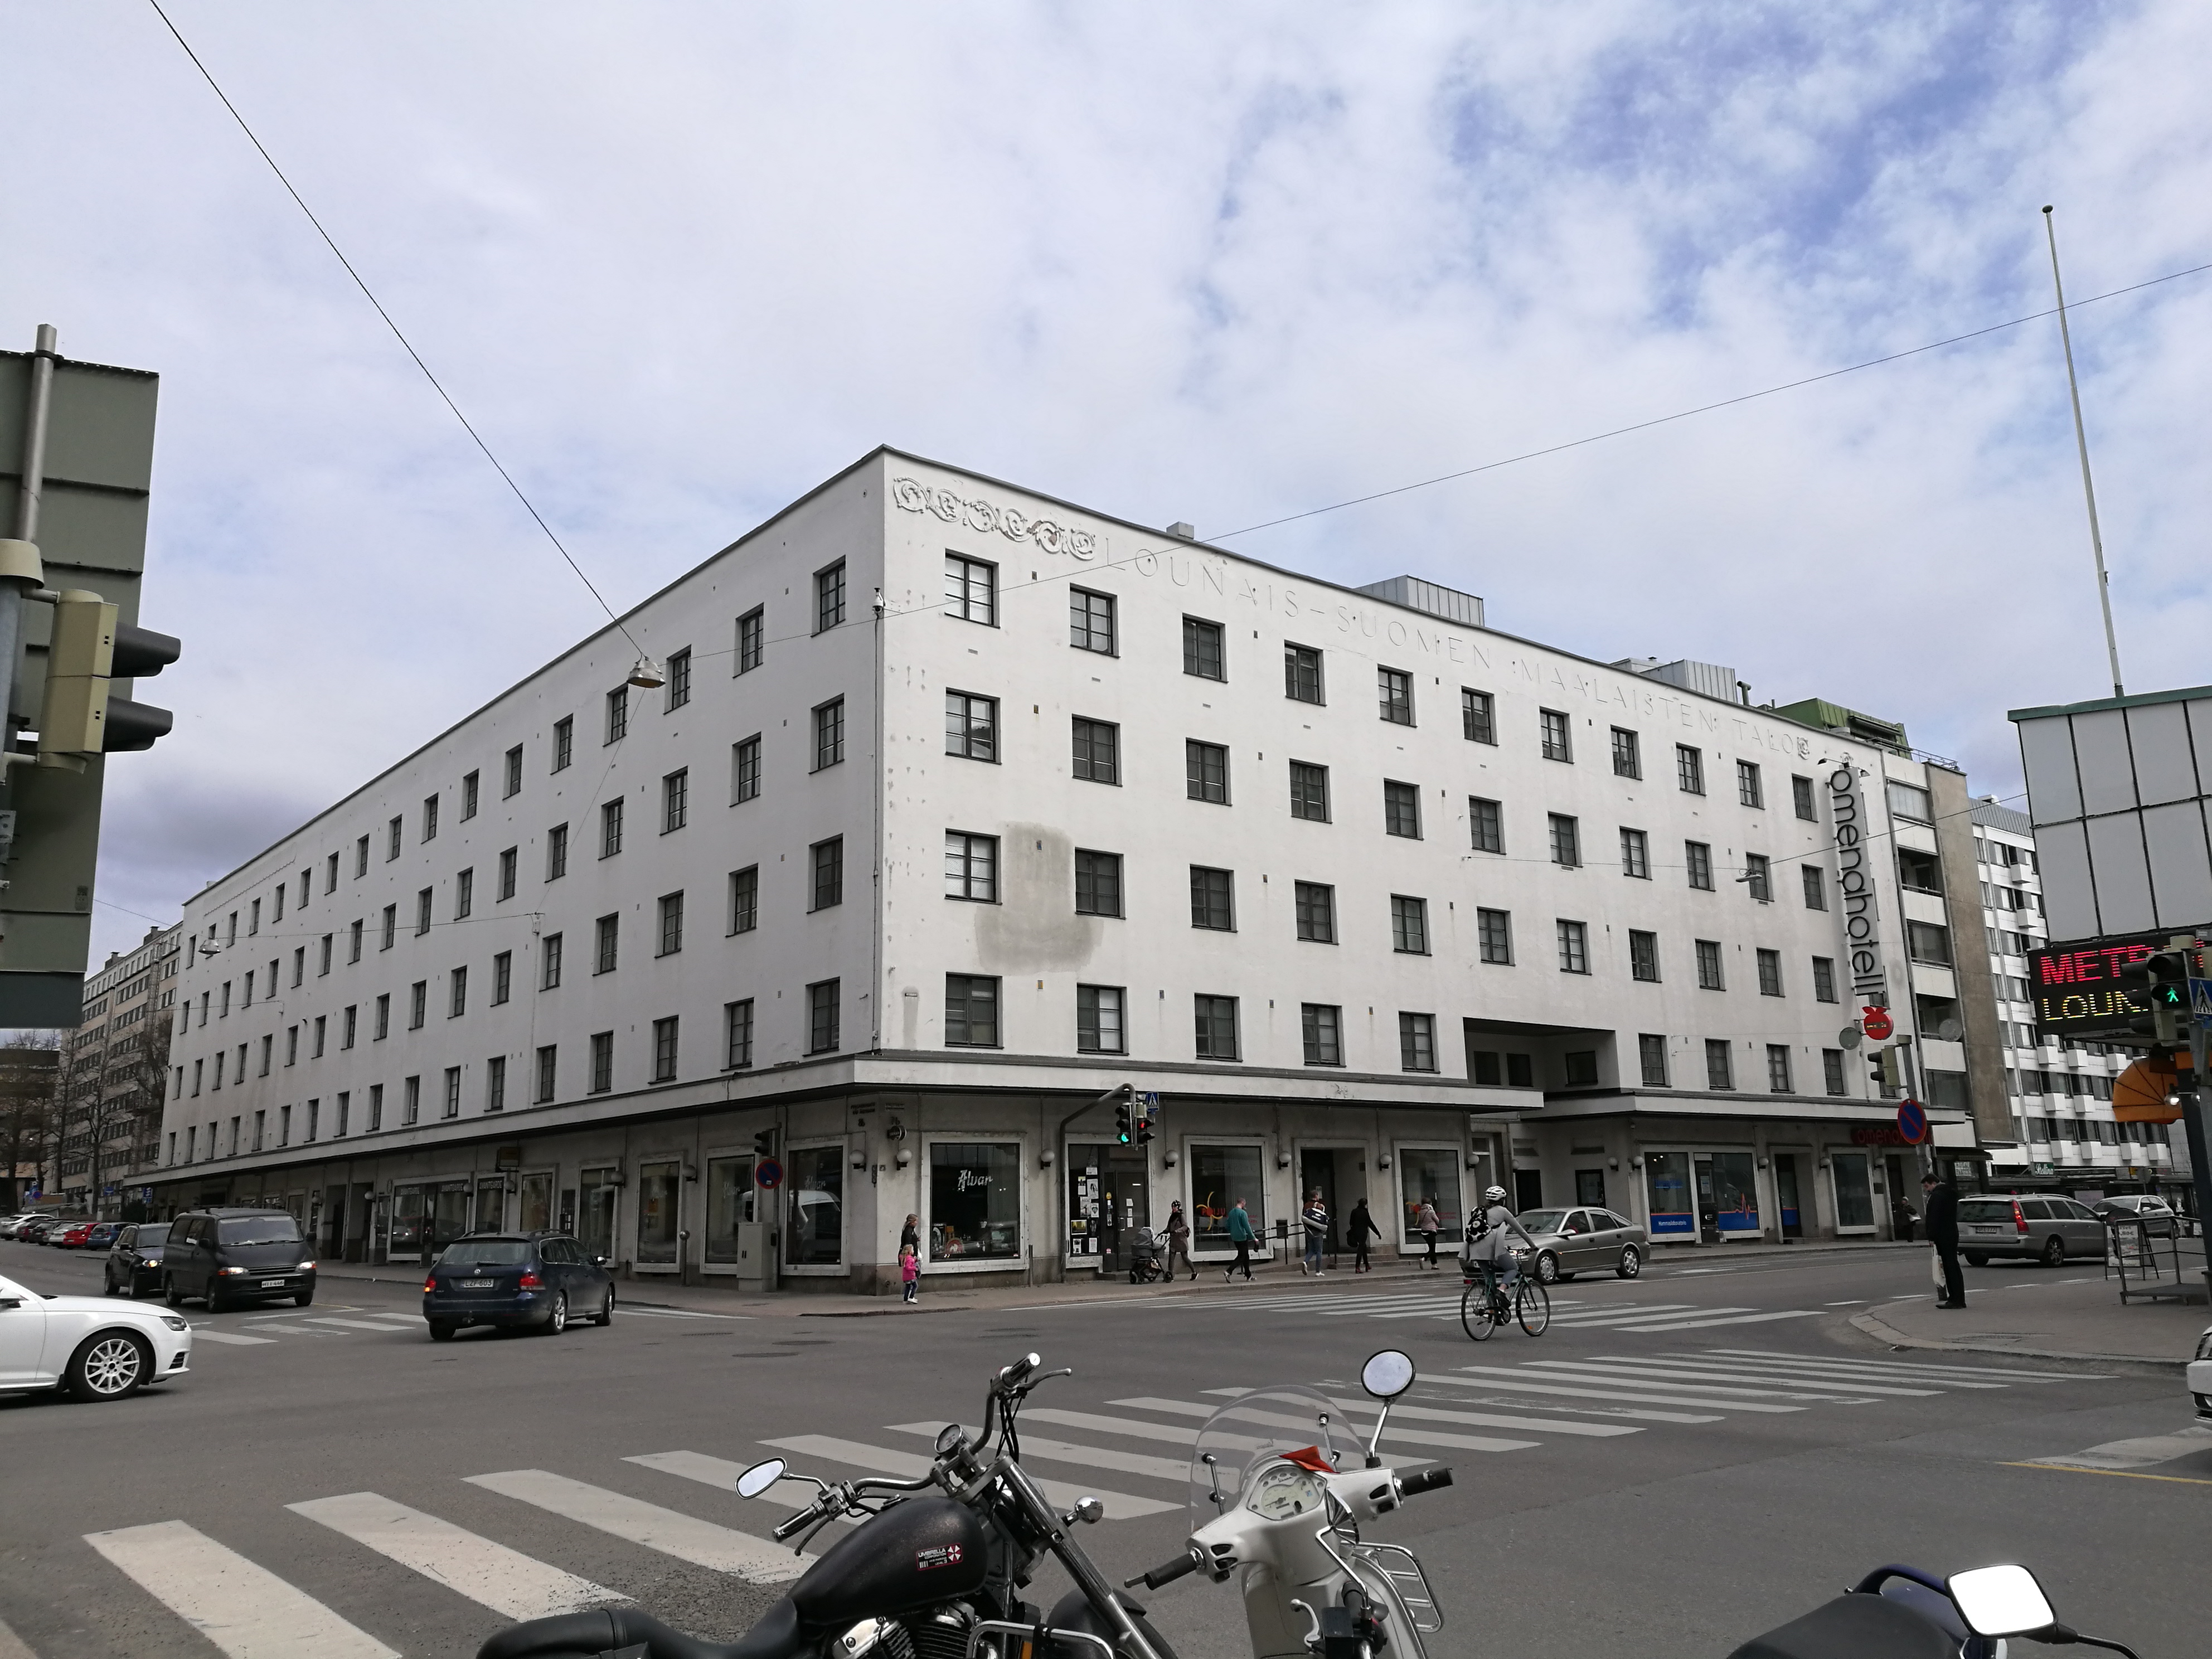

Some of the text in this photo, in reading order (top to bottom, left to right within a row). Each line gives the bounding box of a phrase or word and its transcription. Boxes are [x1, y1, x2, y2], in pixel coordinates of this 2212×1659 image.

[1521, 658, 1715, 734] MAALAISTEN
[1732, 719, 1793, 754] TALO
[1830, 769, 1884, 997] omenahotelli
[479, 1180, 503, 1190] AVANTGARDE
[465, 1279, 492, 1287] LZF-603
[918, 1548, 947, 1558] UMBRELLA
